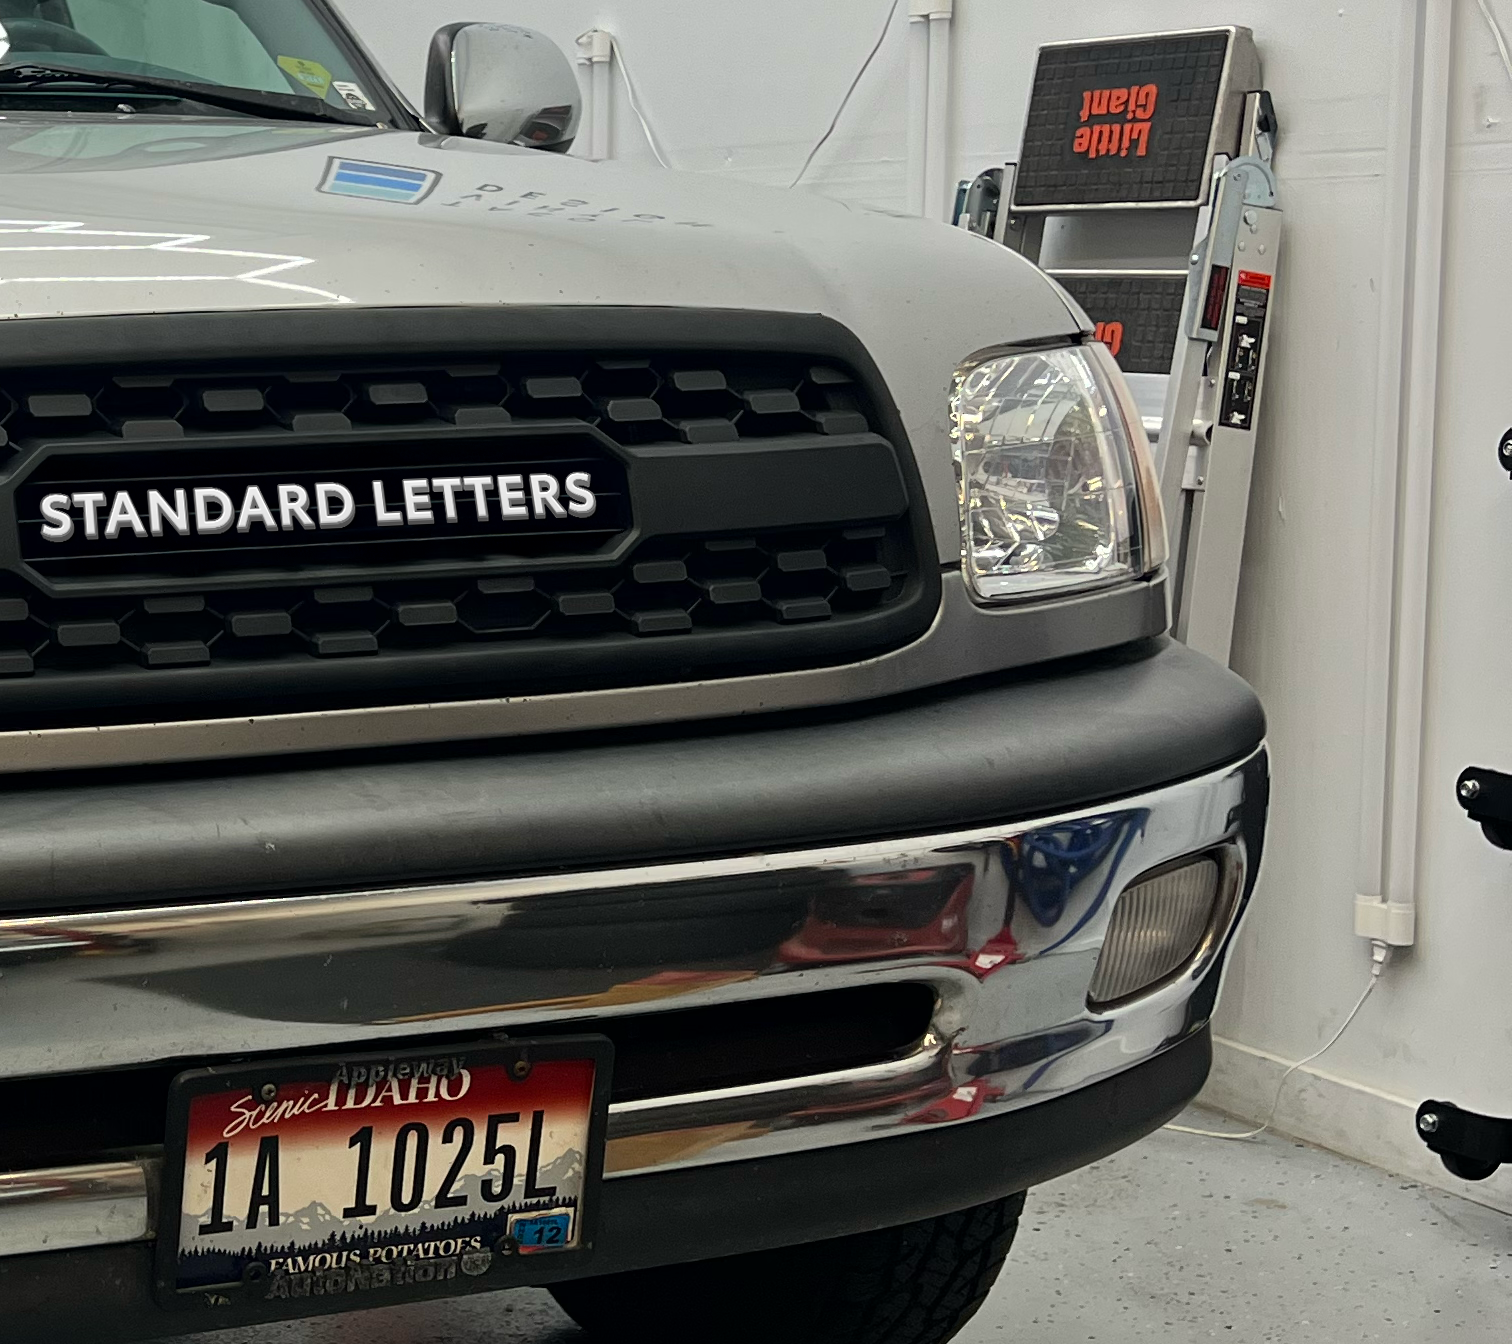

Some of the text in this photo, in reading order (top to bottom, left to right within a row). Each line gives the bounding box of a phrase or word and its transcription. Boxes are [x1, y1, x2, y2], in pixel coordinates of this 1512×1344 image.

[1079, 83, 1159, 123] Giant
[1073, 122, 1152, 159] Little
[39, 471, 597, 542] STANDARD LETTERS
[223, 1068, 471, 1138] Scenic IDAHO
[198, 1109, 558, 1236] 1A 1025L
[268, 1236, 482, 1274] FAMOUS POTATOES
[533, 1226, 562, 1245] 12
